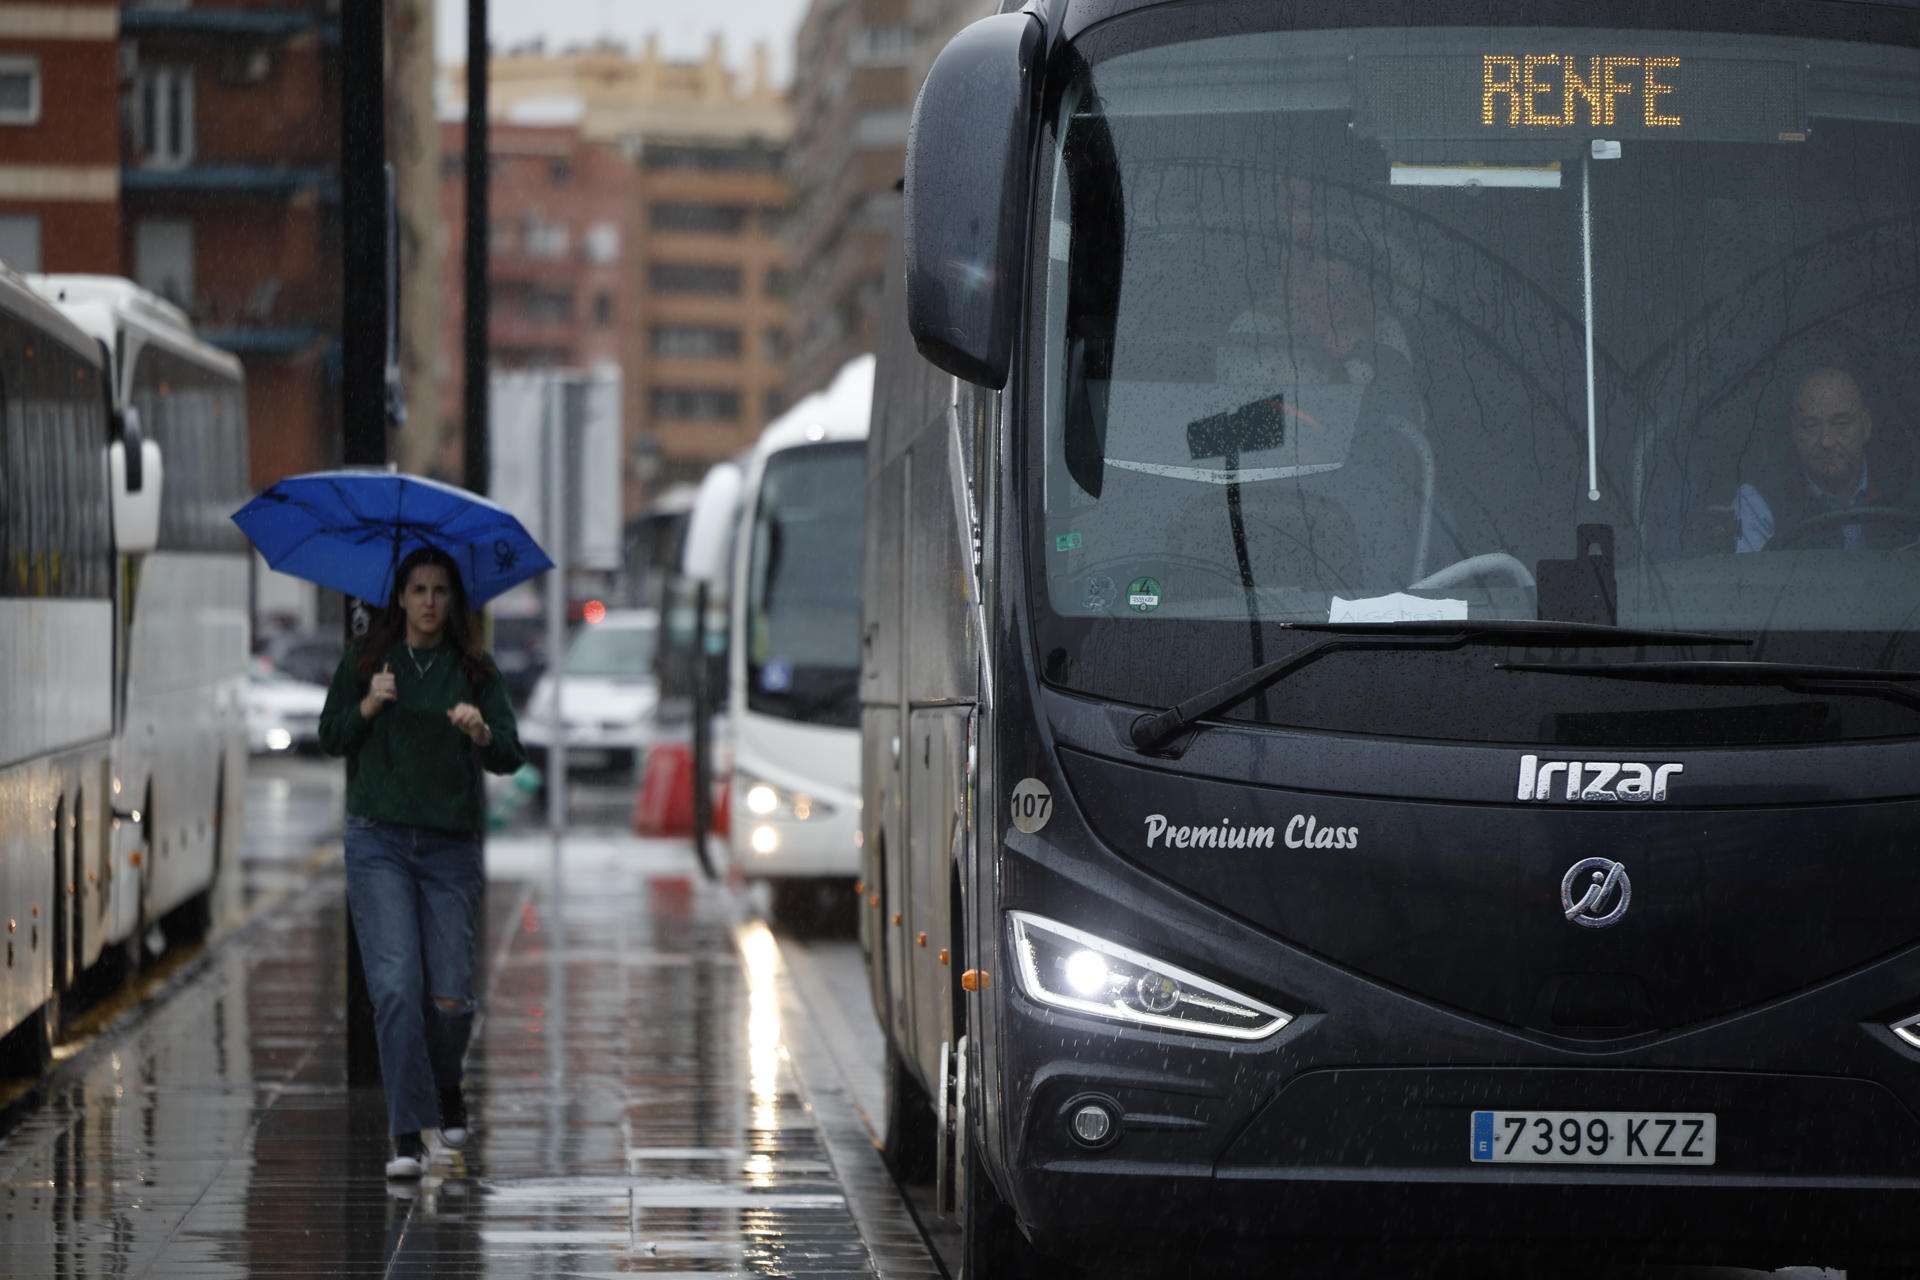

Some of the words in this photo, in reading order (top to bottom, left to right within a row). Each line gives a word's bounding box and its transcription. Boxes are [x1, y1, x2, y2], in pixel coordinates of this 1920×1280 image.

[1482, 54, 1682, 127] RENFE
[1517, 755, 1684, 801] Irizar
[1012, 793, 1051, 818] 107
[1144, 814, 1275, 849] Premium
[1284, 814, 1360, 849] Class
[1479, 1141, 1488, 1152] E
[1503, 1117, 1609, 1156] 7399
[1626, 1118, 1705, 1157] KZZ
